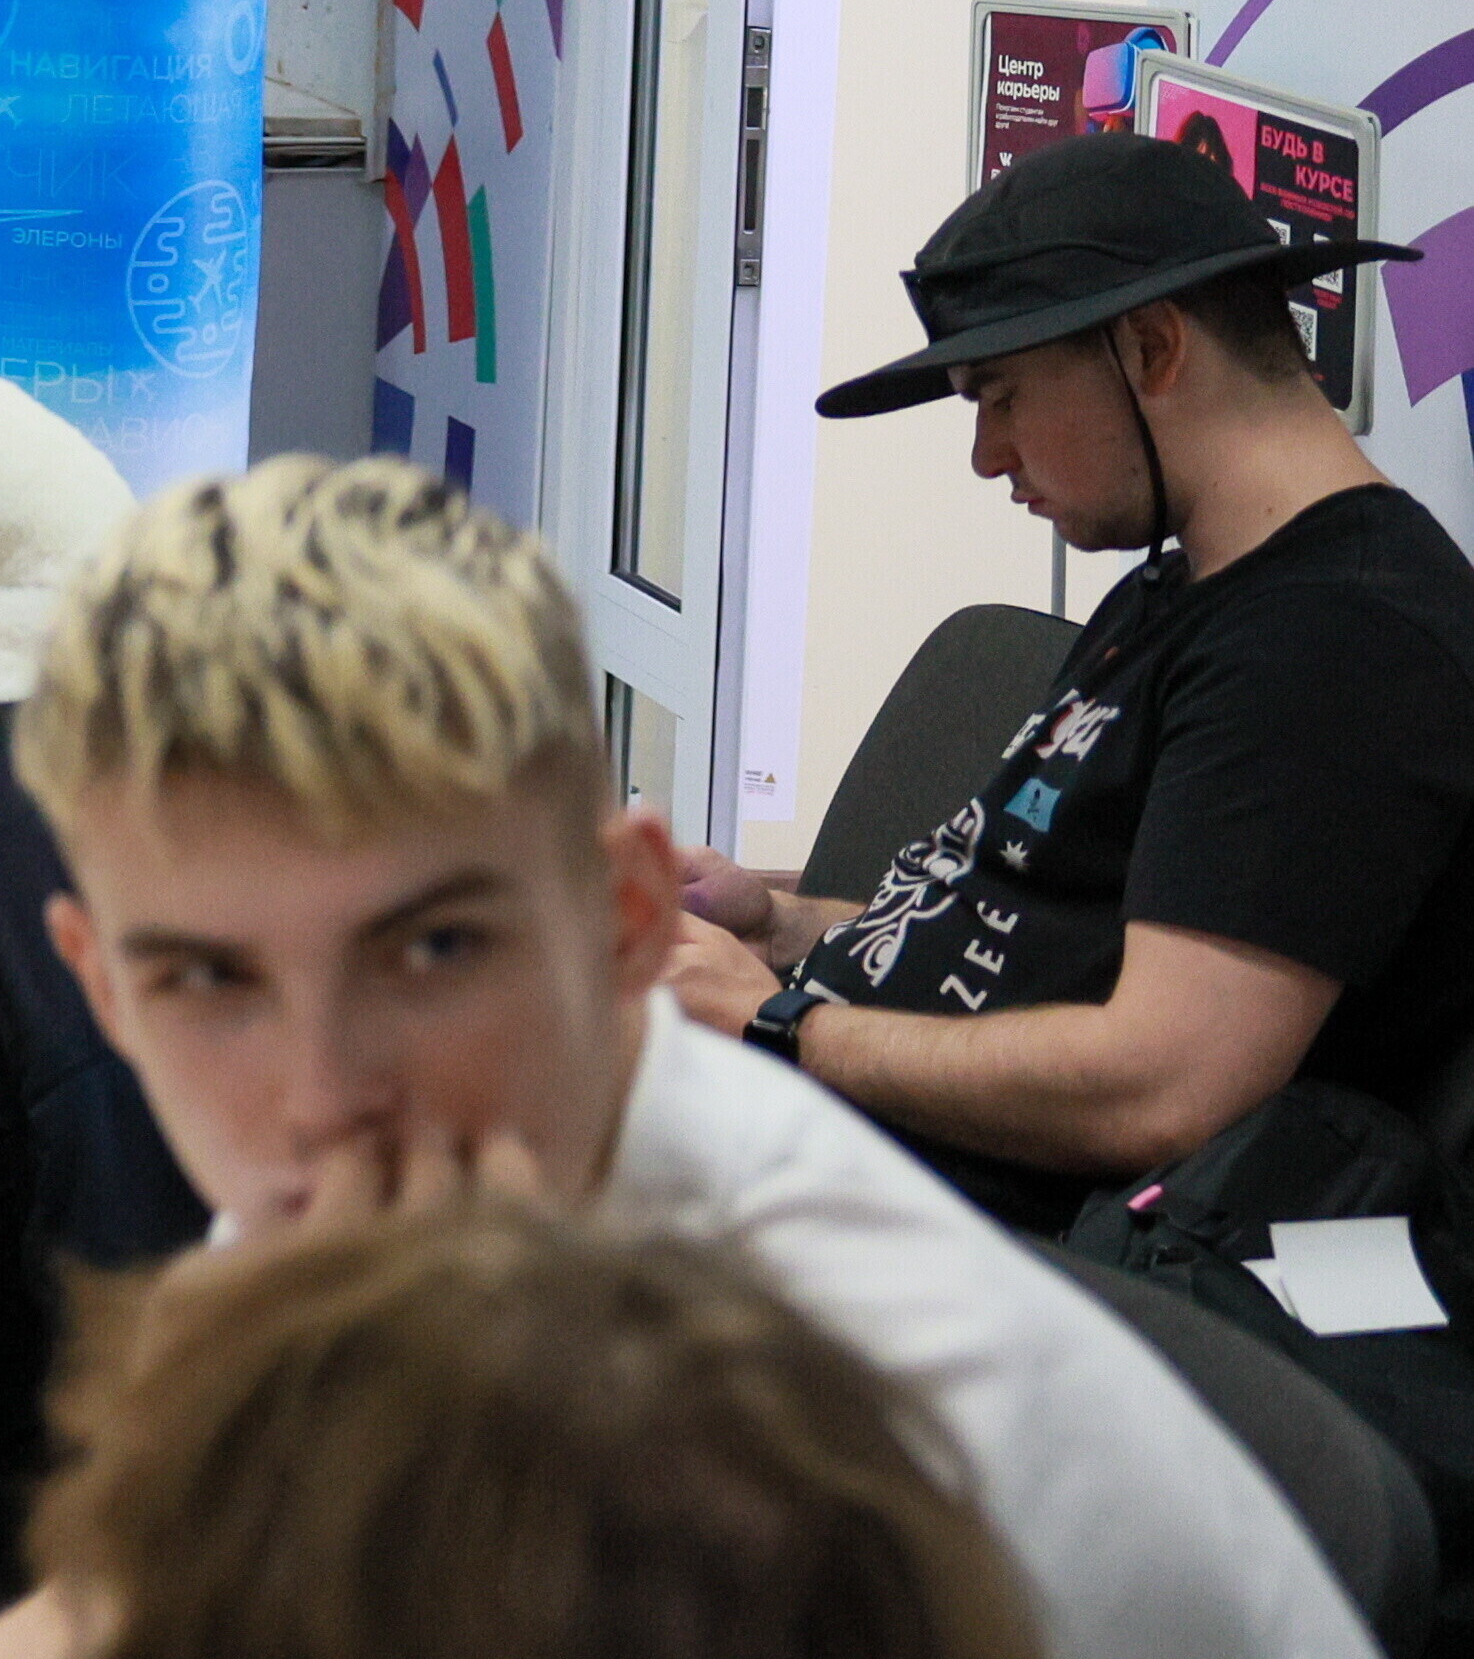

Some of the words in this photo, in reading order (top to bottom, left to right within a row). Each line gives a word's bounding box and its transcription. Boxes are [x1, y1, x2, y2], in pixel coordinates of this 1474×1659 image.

[9, 49, 213, 81] НАВИГАЦИЯ
[997, 54, 1044, 80] Центр
[996, 79, 1061, 103] карьеры
[1261, 125, 1309, 160] БУДЬ
[1312, 140, 1326, 164] В
[1295, 165, 1355, 203] КУРСЕ
[10, 226, 123, 249] ЭЛЕРОНЫ
